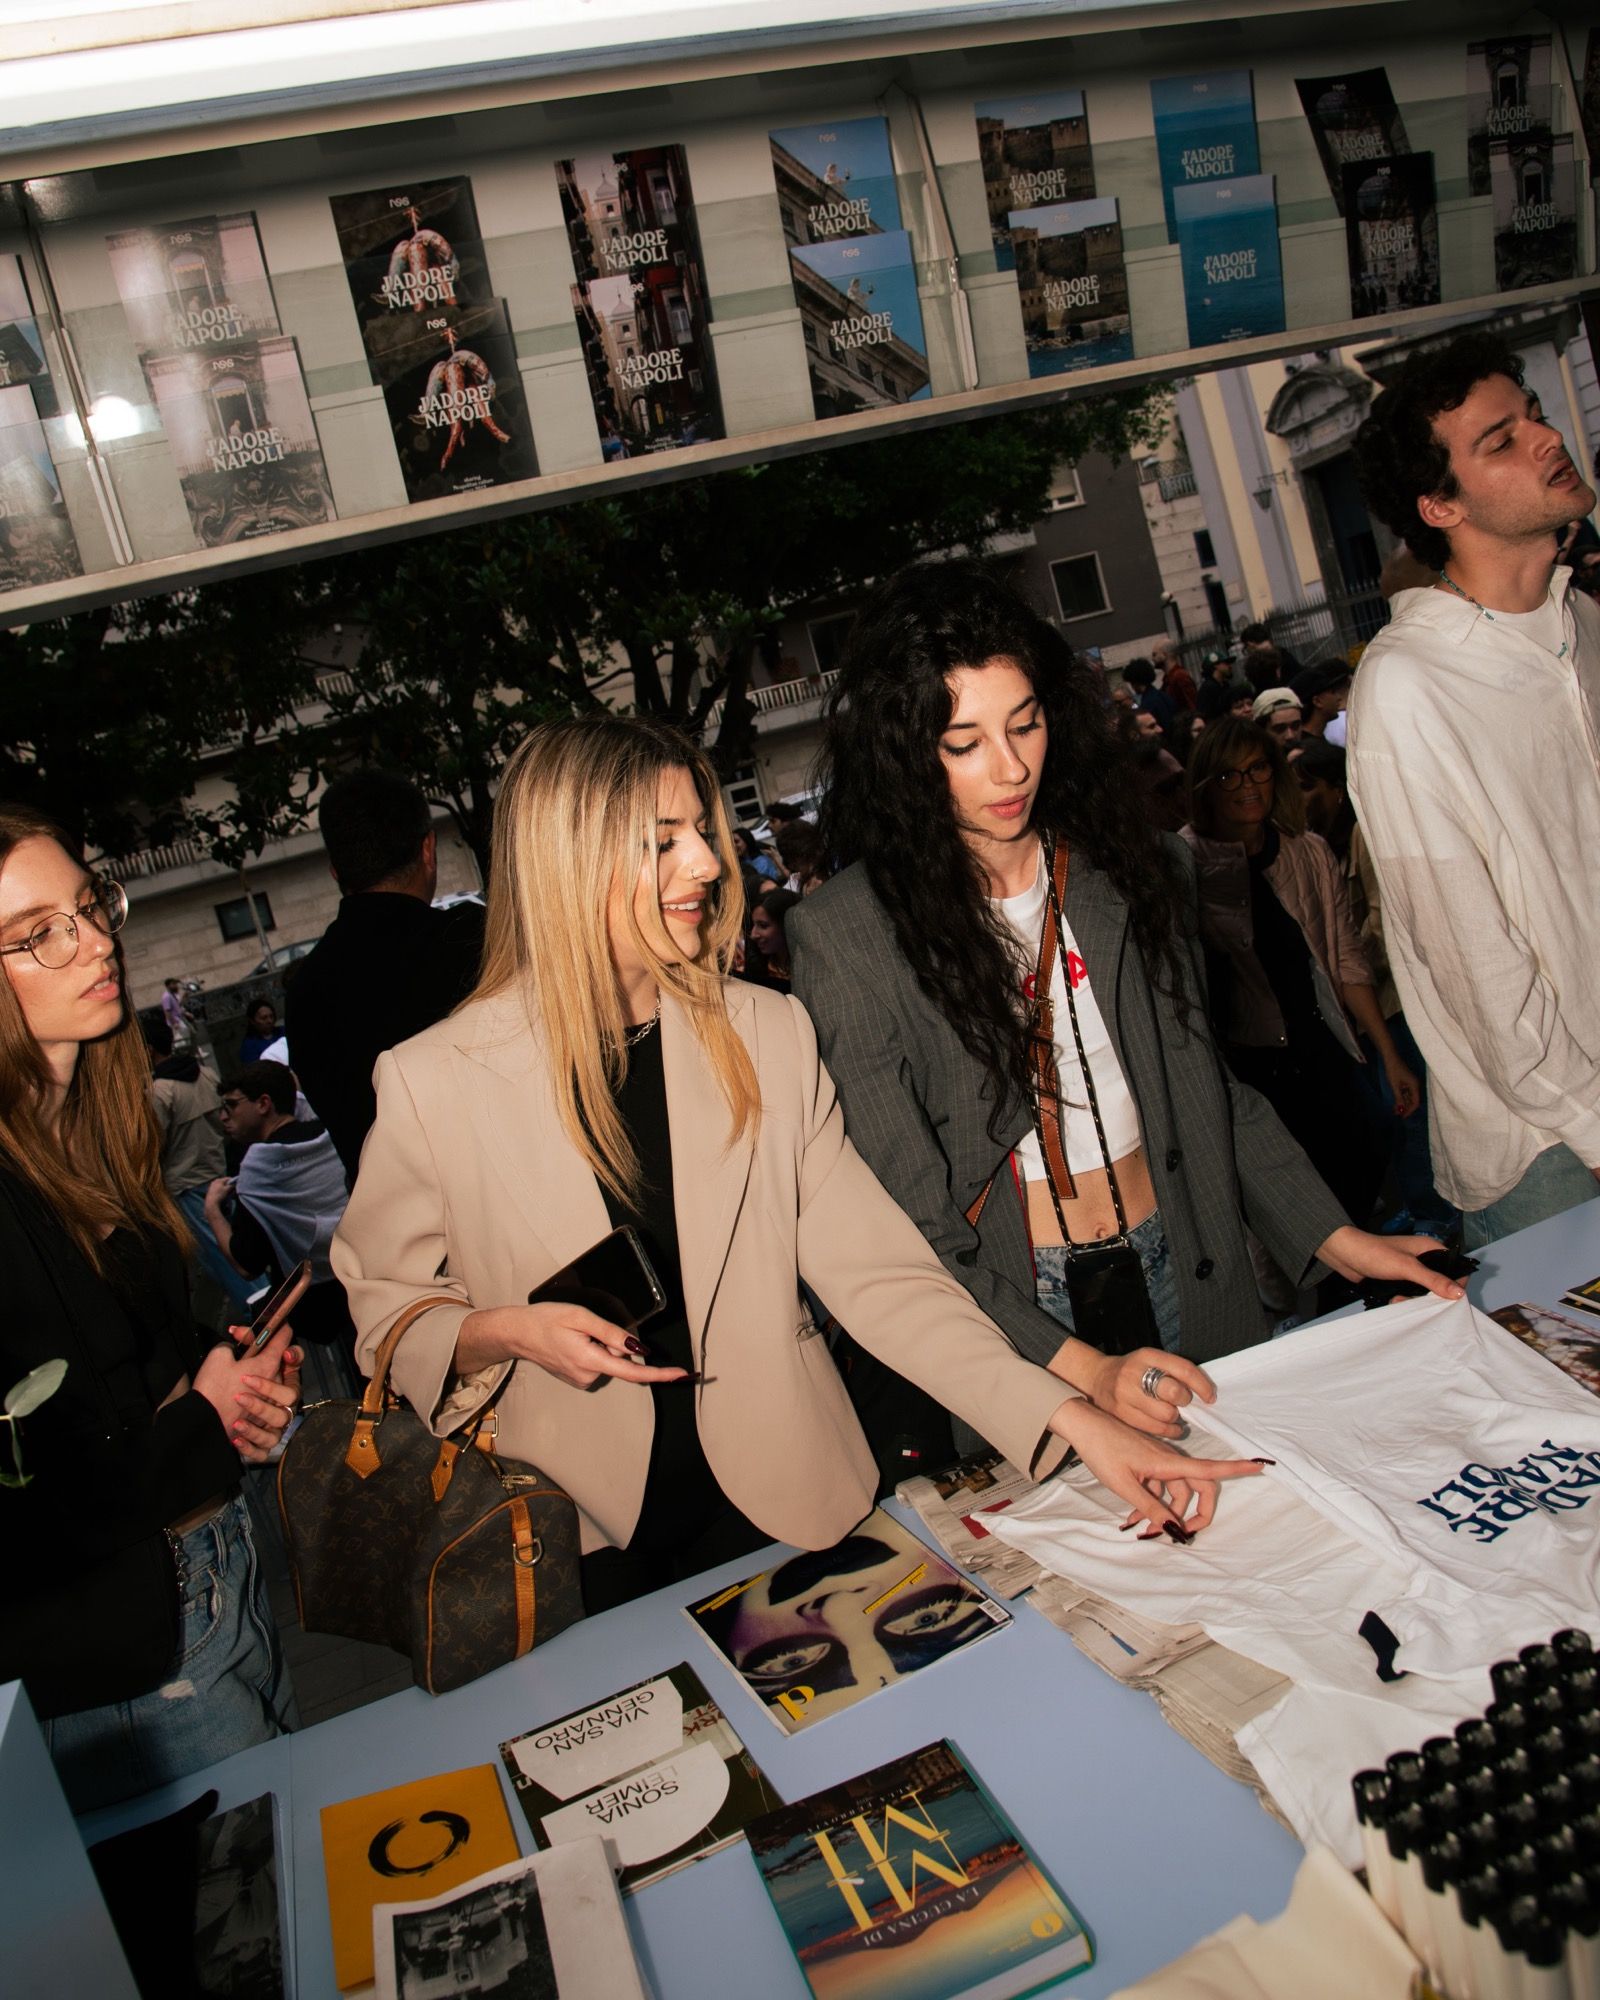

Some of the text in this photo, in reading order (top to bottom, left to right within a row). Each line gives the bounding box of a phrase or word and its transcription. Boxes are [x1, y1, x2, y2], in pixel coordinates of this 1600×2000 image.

[1488, 118, 1530, 137] NAPOLI
[1181, 145, 1235, 166] J'ADORE
[1009, 168, 1067, 190] J'ADORE
[1185, 159, 1235, 180] NAPOLI
[1013, 183, 1067, 204] NAPOLI
[808, 198, 871, 221] J'ADORE
[813, 214, 871, 236] NAPOLI
[1514, 216, 1555, 234] NAPOLI
[600, 229, 668, 254] J'ADORE
[1368, 238, 1413, 258] NAPOLI
[605, 246, 668, 270] NAPOLI
[1203, 249, 1256, 271] J'ADORE
[381, 264, 455, 293] J'ADORE
[1207, 263, 1256, 284] NAPOLI
[387, 282, 456, 309] NAPOLI
[1042, 275, 1100, 298] J'ADORE
[1047, 290, 1100, 312] NAPOLI
[172, 320, 243, 348] NAPOLI
[830, 311, 893, 336] J'ADORE
[834, 327, 893, 351] NAPOLI
[615, 348, 683, 374] J'ADORE
[620, 364, 684, 390] NAPOLI
[418, 384, 492, 413] J'ADORE
[424, 401, 493, 429] NAPOLI
[206, 427, 283, 457] J'ADORE
[213, 444, 284, 473] NAPOLI
[1448, 1452, 1600, 1543] JADRE
[535, 1691, 654, 1749] GENNARO
[554, 1707, 649, 1755] VIA SAN
[585, 1765, 678, 1816] LEIMER
[597, 1780, 679, 1824] SONIA
[863, 1886, 980, 1947] LA CUCINA DI
